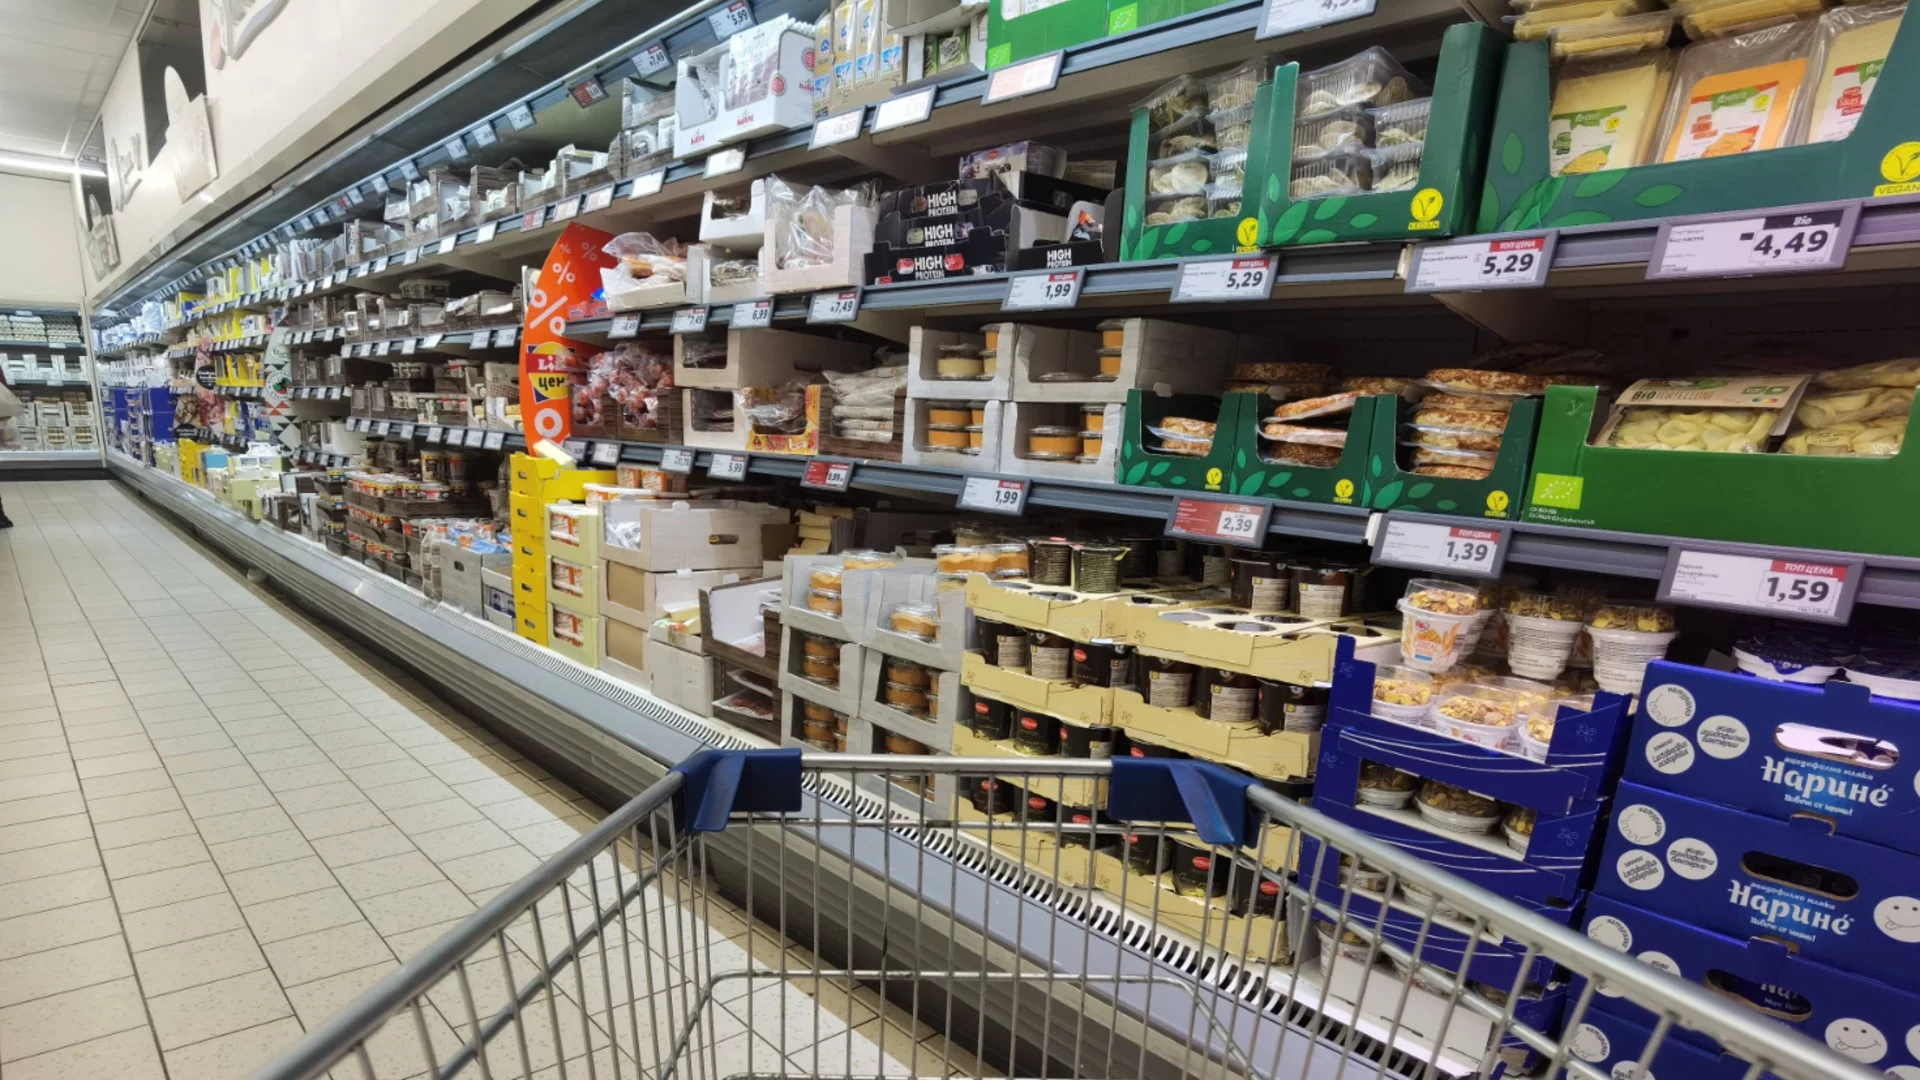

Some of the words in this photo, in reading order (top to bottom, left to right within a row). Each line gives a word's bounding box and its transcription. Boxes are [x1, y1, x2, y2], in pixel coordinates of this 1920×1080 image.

[927, 191, 957, 208] HIGH
[928, 205, 958, 217] PROTEIN
[1793, 216, 1813, 226] Bio
[924, 223, 954, 241] HIGH
[1754, 230, 1829, 258] 4,49
[1047, 248, 1072, 260] HIGH
[914, 255, 943, 271] HIGH
[1483, 253, 1534, 276] 5,29
[915, 270, 945, 280] PROTEIN
[1227, 271, 1263, 289] 5,29
[1045, 284, 1071, 299] 1,99
[995, 489, 1018, 505] 1,99
[1222, 517, 1253, 532] 2,39
[1446, 541, 1488, 562] 1,39
[1784, 563, 1806, 573] ТОП
[1806, 565, 1834, 575] ЦЕНА
[1767, 576, 1830, 602] 1,59
